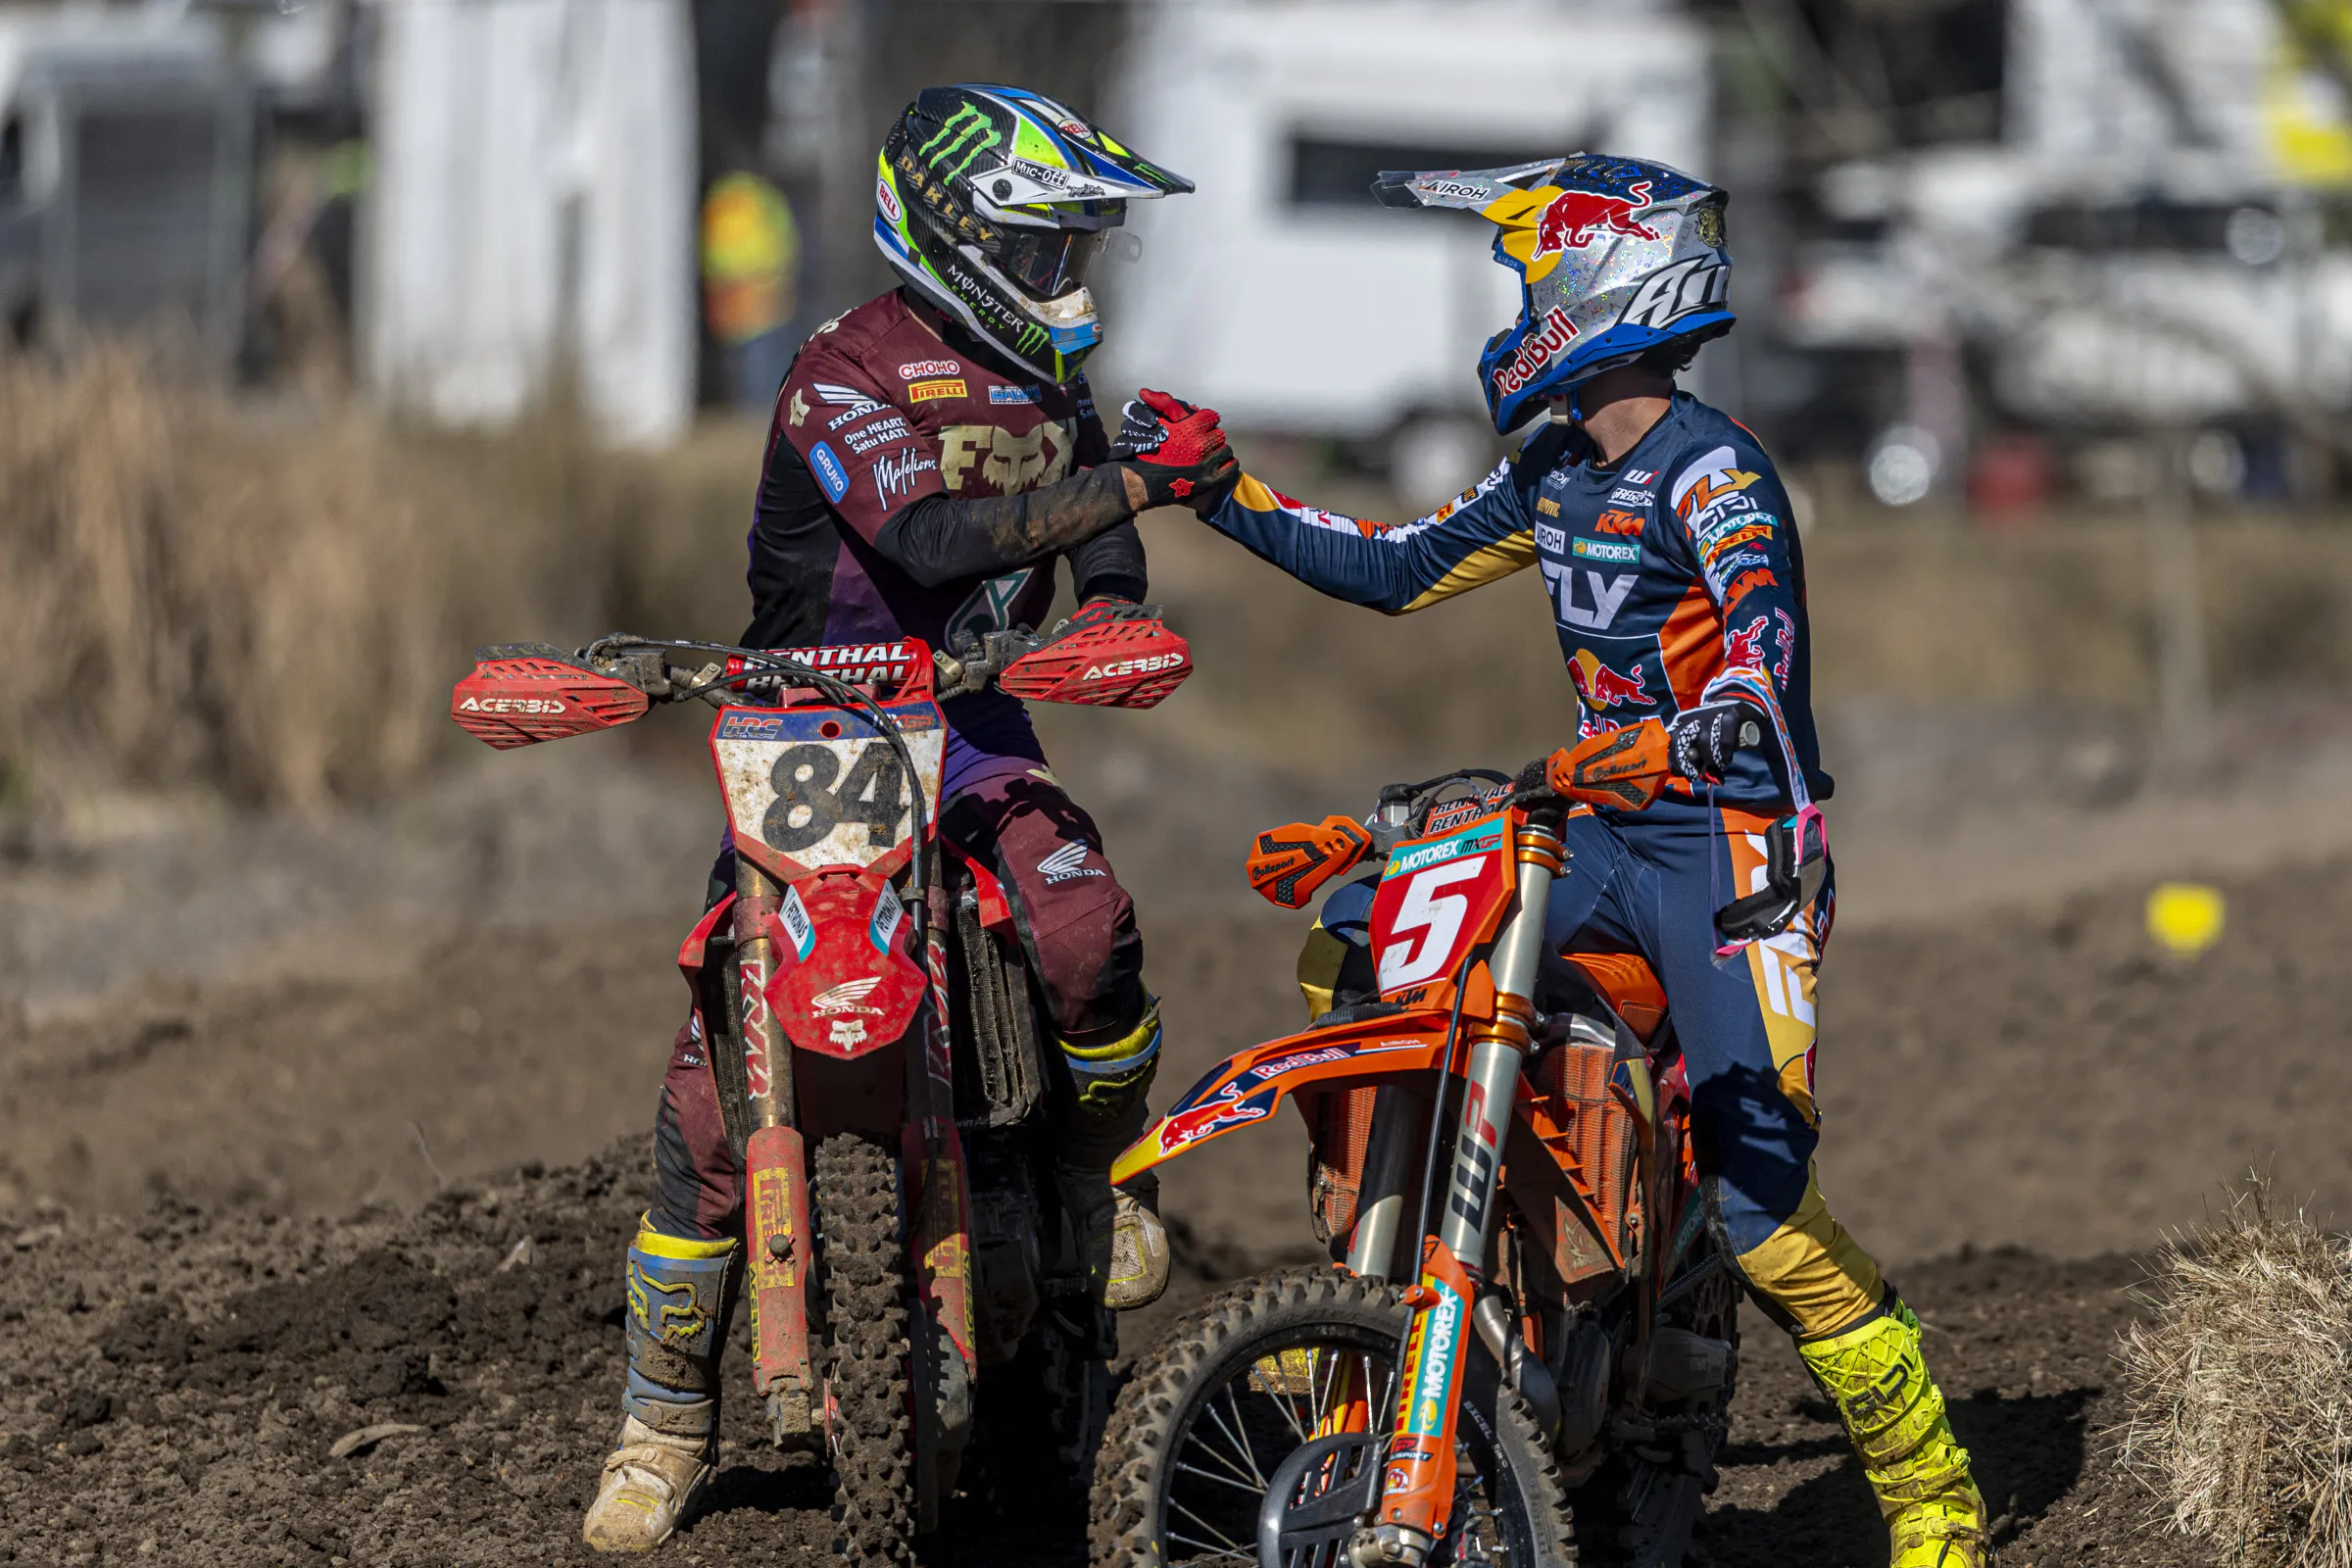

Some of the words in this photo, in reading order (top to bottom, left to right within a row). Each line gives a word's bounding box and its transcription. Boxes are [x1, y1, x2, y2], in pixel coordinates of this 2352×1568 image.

[1014, 162, 1067, 188] Muc-Off
[1421, 180, 1490, 200] AIROH
[879, 183, 897, 218] BELL
[902, 156, 994, 242] OAKLEY
[1496, 255, 1519, 268] AIROH
[948, 265, 1024, 333] MONSTER
[952, 284, 1005, 330] ENERGY
[899, 359, 961, 381] CHOHO
[911, 382, 965, 401] PIRELLI
[845, 430, 867, 445] One
[867, 417, 906, 436] HEART.
[853, 436, 878, 455] Satu
[816, 449, 844, 492] GRUKO
[1594, 509, 1645, 536] KTM
[1587, 542, 1637, 561] MOTOREX
[1540, 556, 1640, 630] FLY
[722, 716, 783, 735] HRC
[762, 741, 911, 853] 84
[1399, 840, 1459, 873] MOTOREX
[1045, 868, 1107, 886] HONDA
[1379, 856, 1487, 993] 5
[811, 1005, 885, 1019] HONDA
[1250, 1056, 1306, 1080] Red
[1298, 1048, 1351, 1066] Bull
[1422, 1287, 1458, 1399] MOTOREX
[1464, 1400, 1494, 1440] EXCEL
